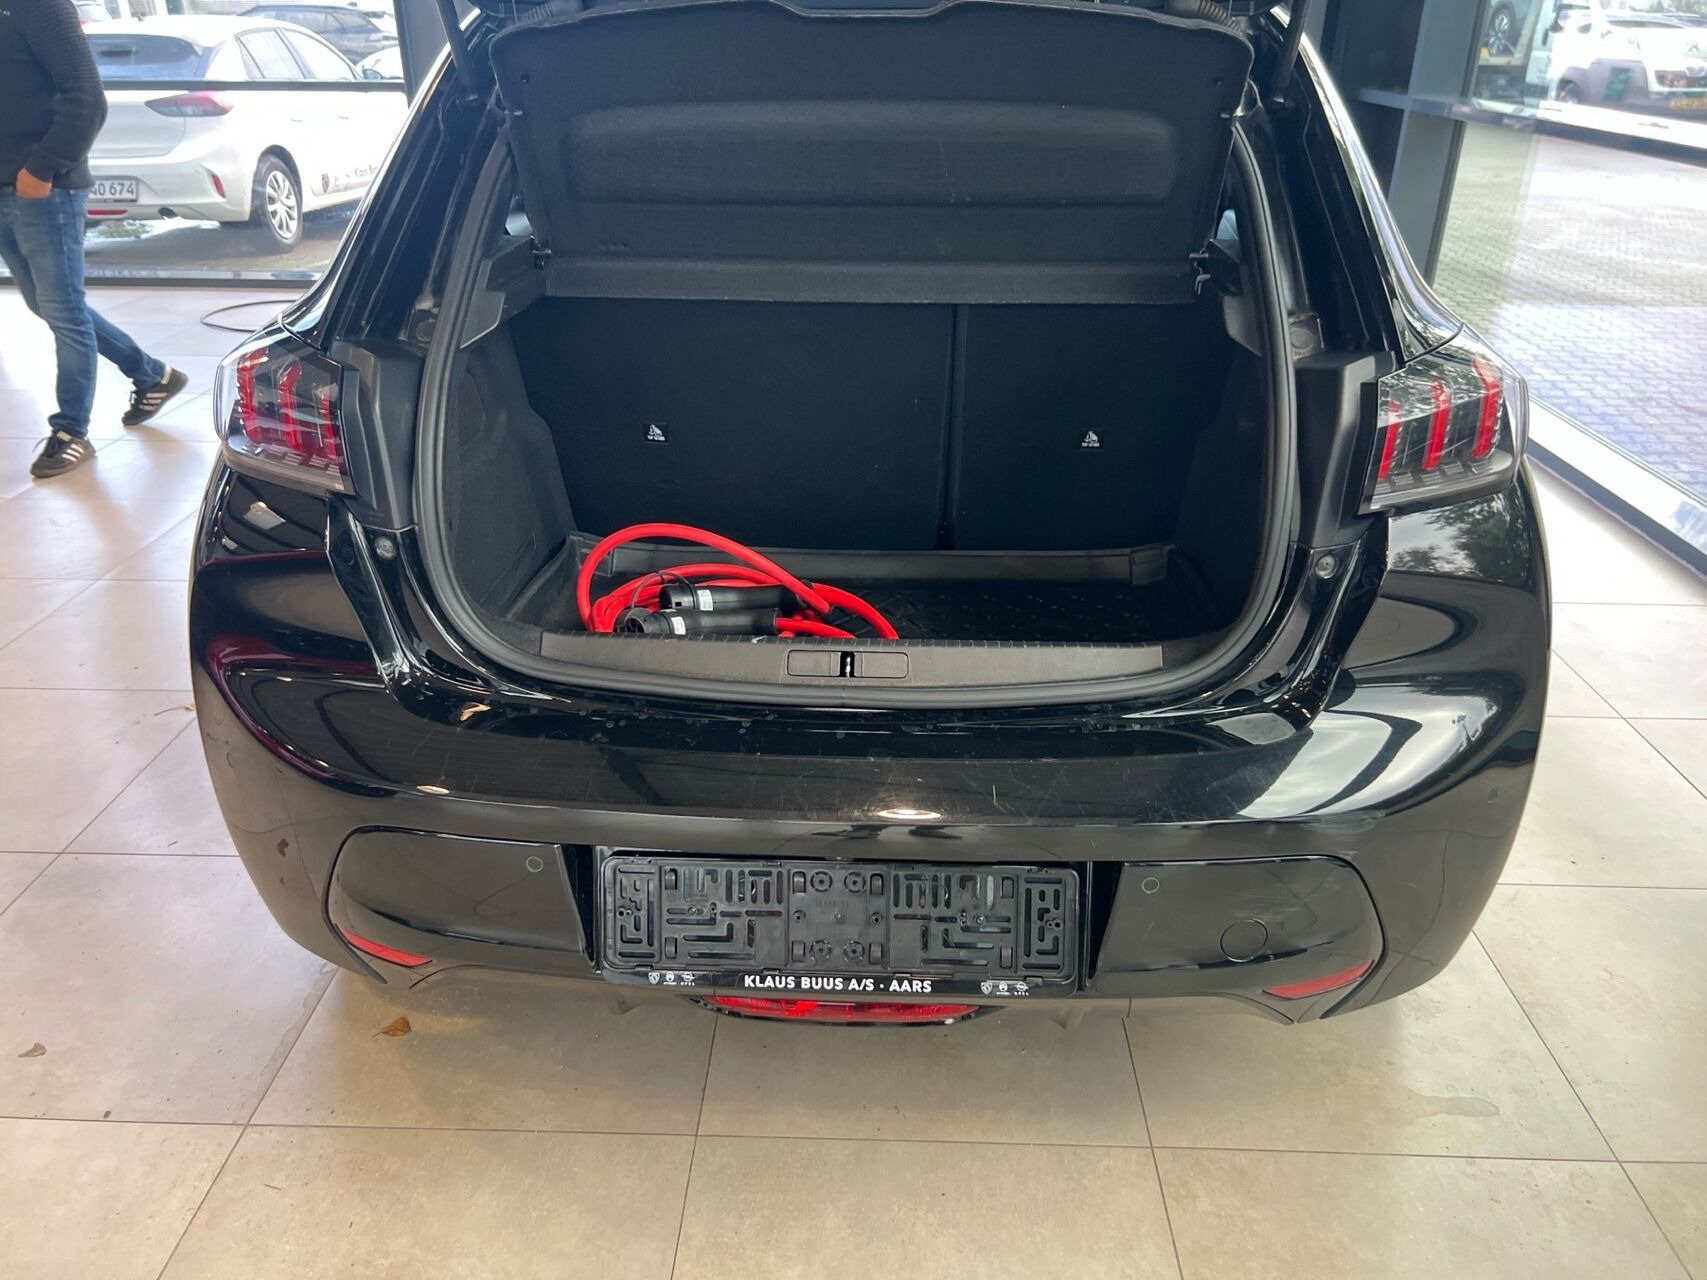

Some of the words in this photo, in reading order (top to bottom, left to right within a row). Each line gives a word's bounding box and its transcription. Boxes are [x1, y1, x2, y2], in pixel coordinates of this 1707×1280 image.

[109, 182, 134, 196] 674
[744, 975, 795, 988] KLAUS
[800, 977, 843, 990] BUUS
[848, 978, 875, 991] A/S
[889, 979, 932, 993] AARS
